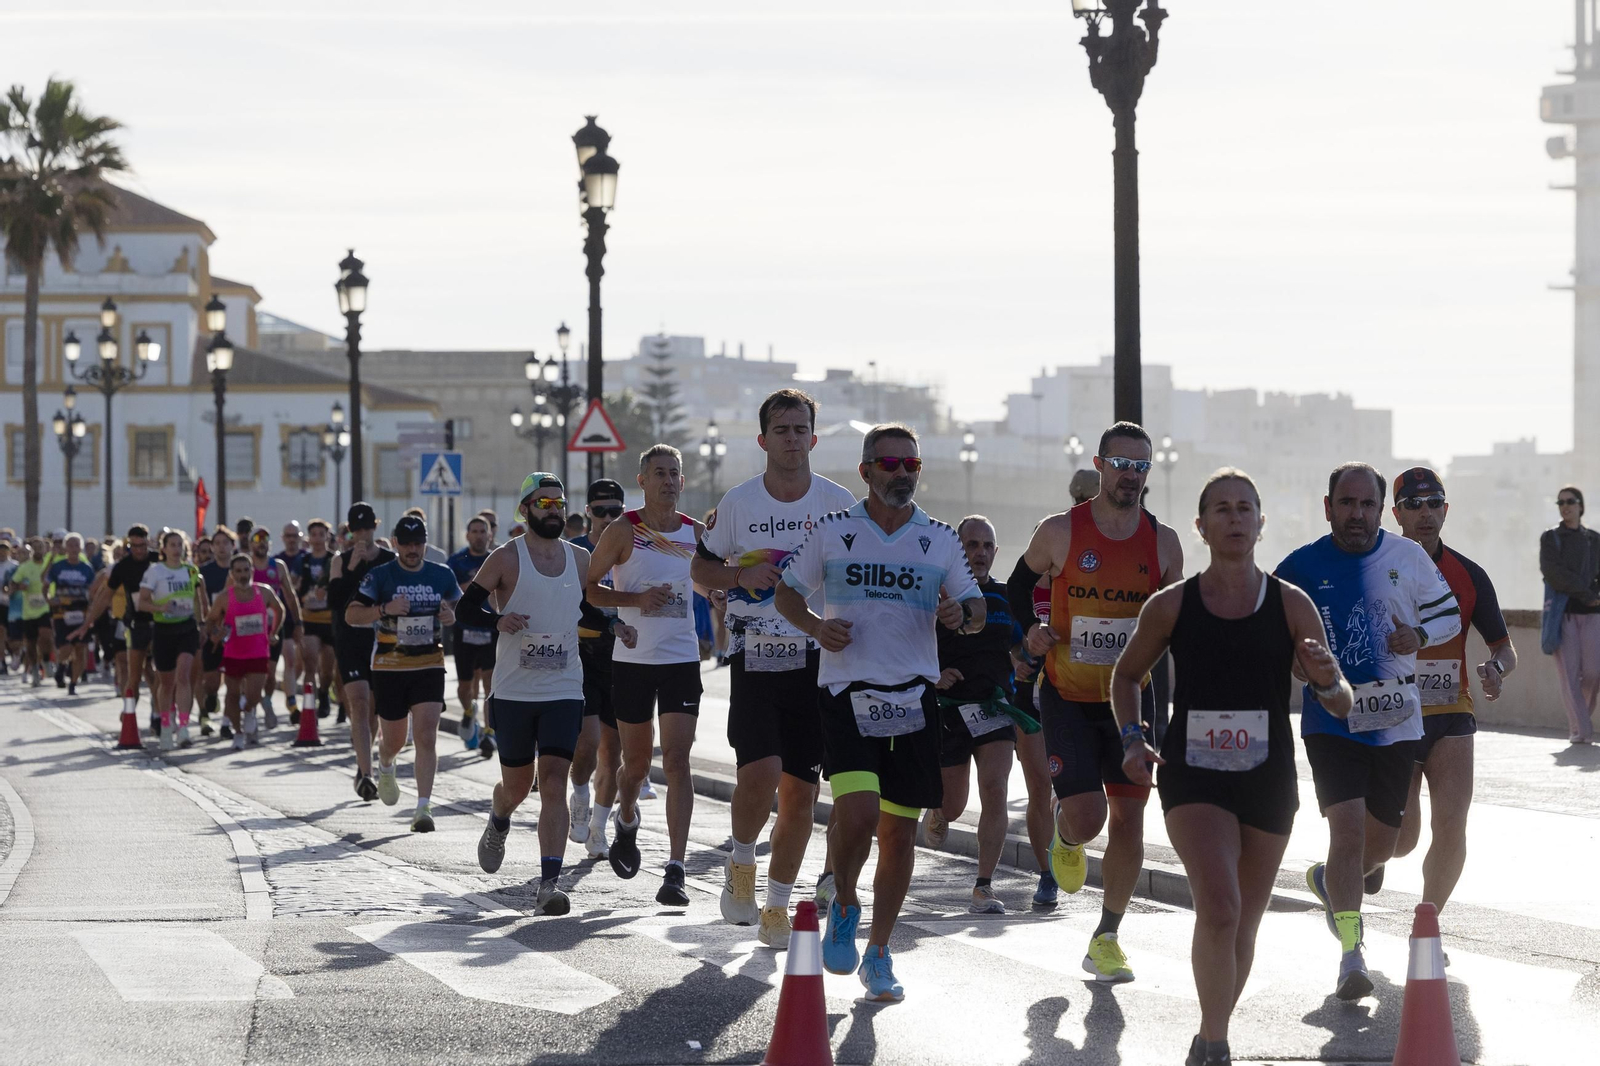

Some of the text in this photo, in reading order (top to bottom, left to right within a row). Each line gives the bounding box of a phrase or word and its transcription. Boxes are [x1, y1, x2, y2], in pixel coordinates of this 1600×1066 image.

[397, 584, 434, 594] media
[864, 589, 903, 601] Telecom
[1067, 585, 1100, 599] CDA
[406, 624, 427, 636] 856
[1080, 631, 1128, 649] 1690
[526, 643, 563, 657] 2454
[753, 642, 798, 658] 1328
[1419, 673, 1452, 690] 728
[1355, 691, 1404, 714] 1029
[868, 702, 906, 721] 885
[1205, 728, 1249, 750] 120
